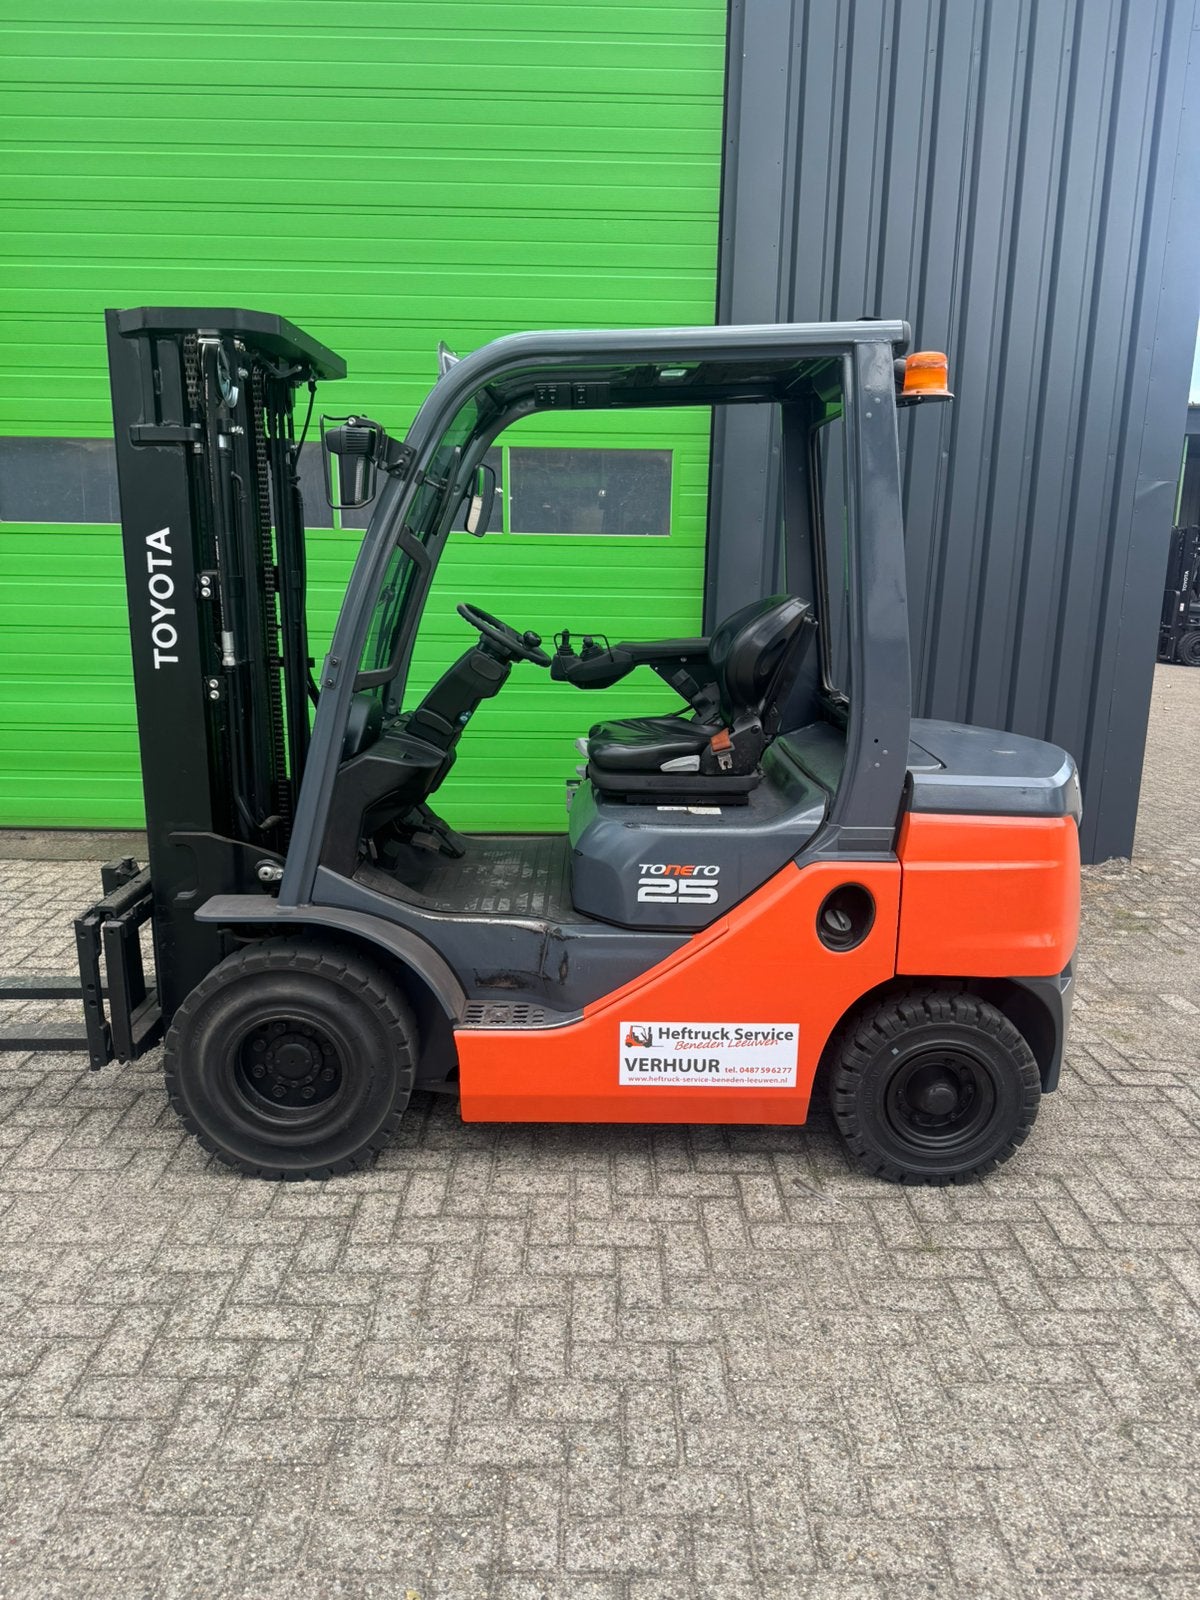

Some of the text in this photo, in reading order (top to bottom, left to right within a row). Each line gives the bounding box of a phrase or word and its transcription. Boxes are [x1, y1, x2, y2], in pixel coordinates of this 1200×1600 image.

[1181, 570, 1190, 592] TOYOTA
[145, 526, 179, 670] TOYOTA
[637, 877, 719, 904] 25
[658, 1026, 794, 1041] Heftruck Service
[674, 1037, 779, 1051] Beneden Leeuwen
[624, 1057, 720, 1073] VERHUUR
[724, 1066, 738, 1074] tel.
[628, 1075, 788, 1084] www.heftruck-service-beneden-leeuwen.nl
